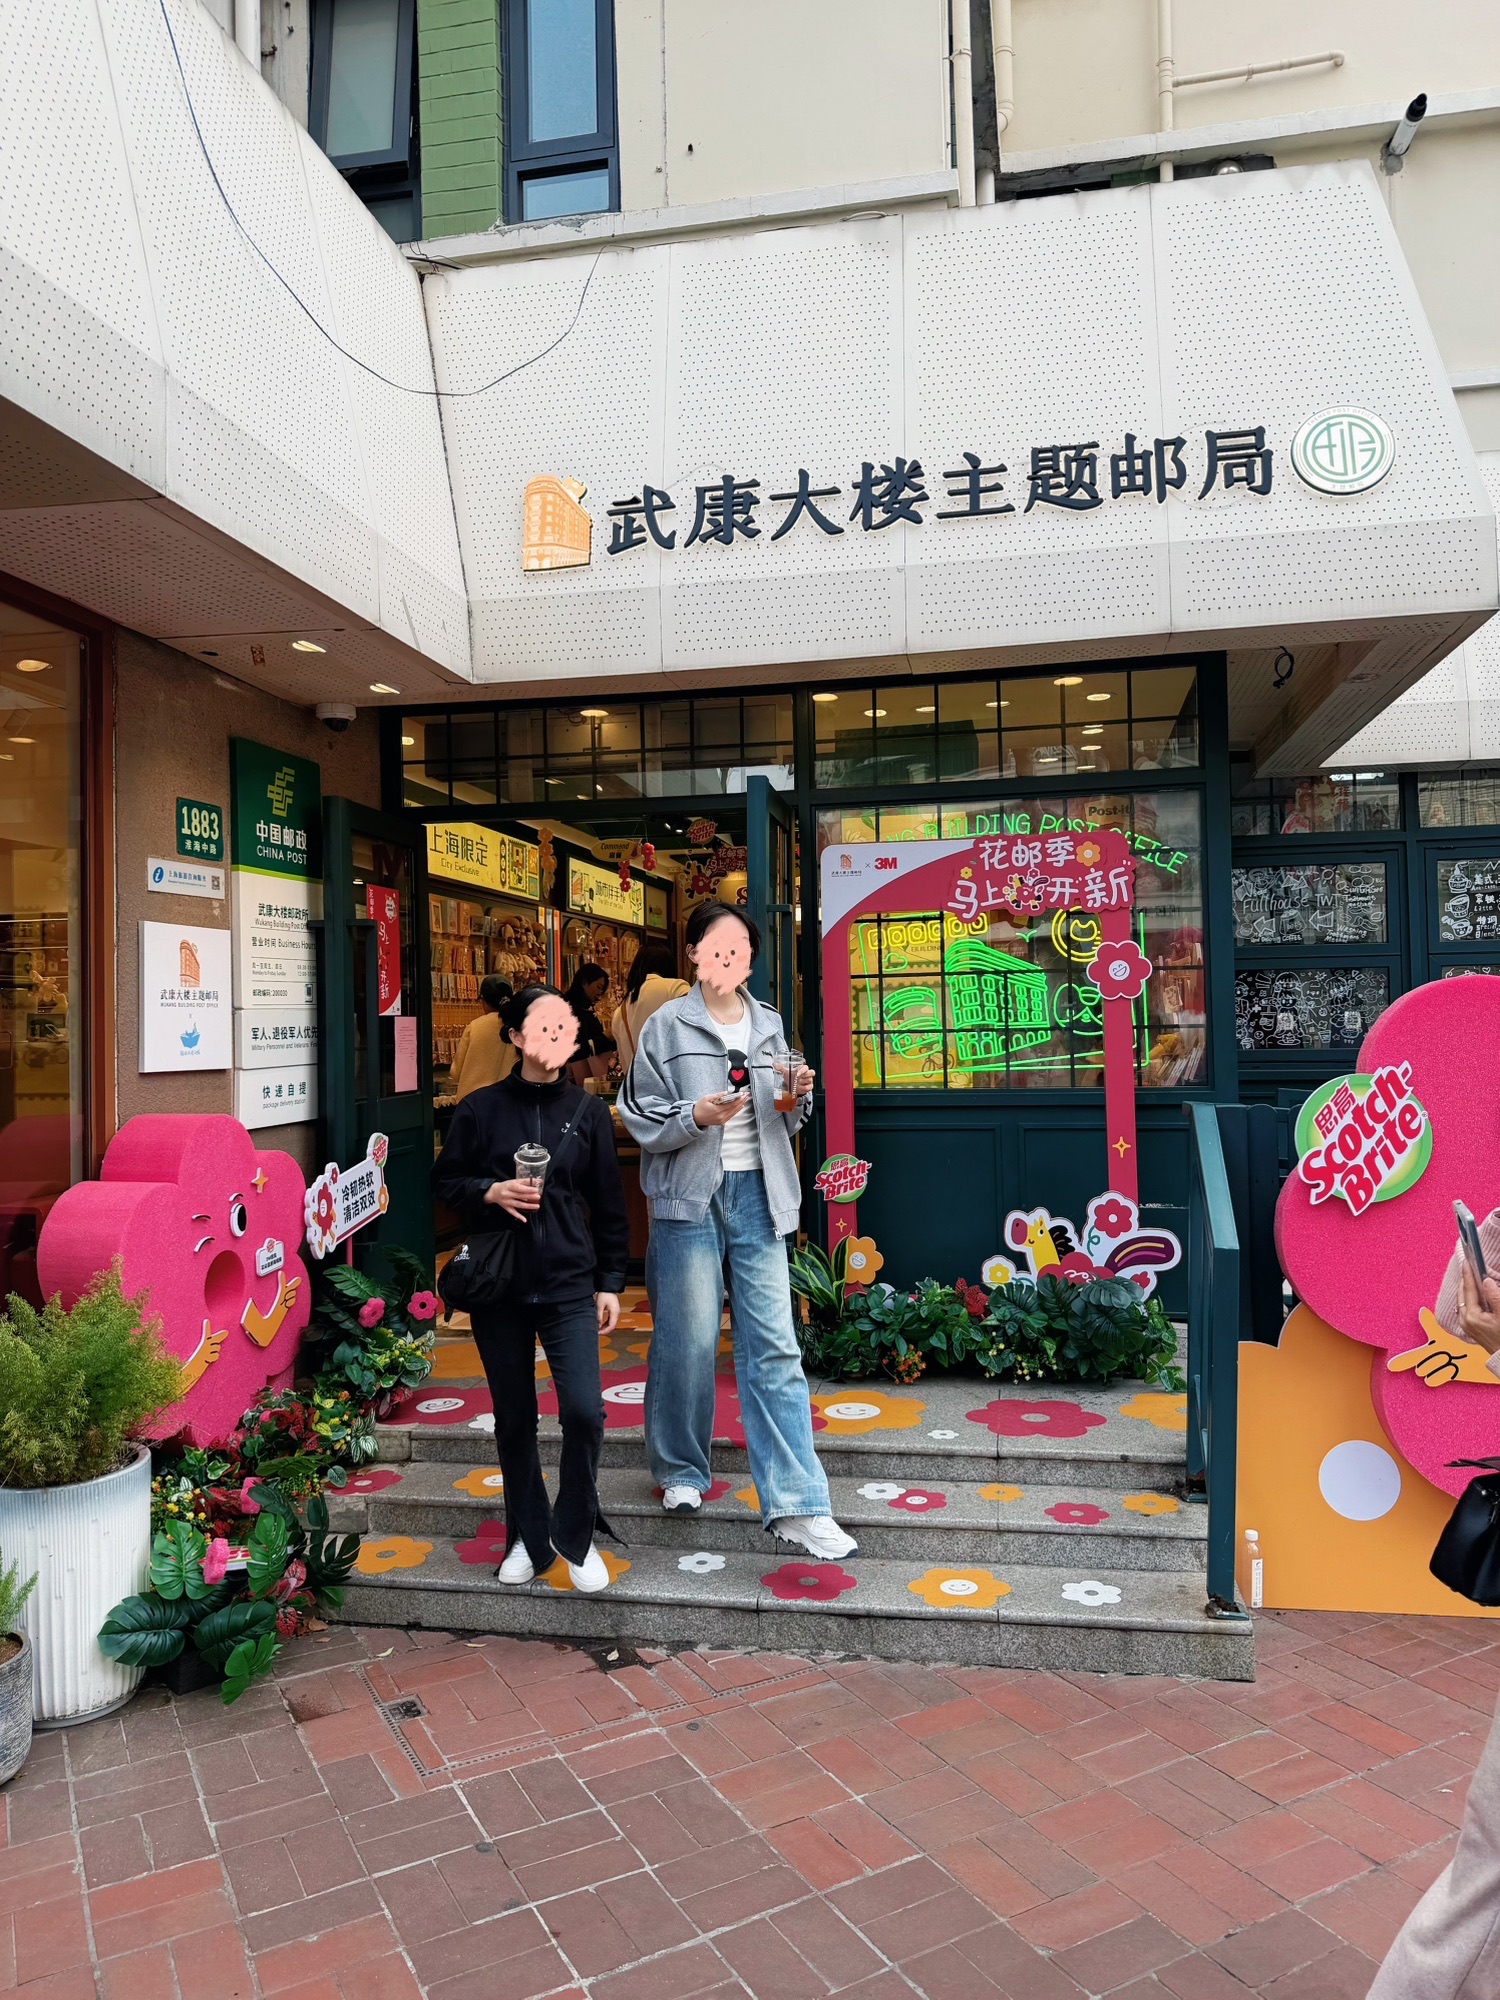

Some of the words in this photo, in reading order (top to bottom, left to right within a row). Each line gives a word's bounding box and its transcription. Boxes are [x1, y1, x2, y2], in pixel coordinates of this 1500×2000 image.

[1353, 409, 1375, 420] OFFICE
[605, 425, 1274, 556] 武康大楼主题邮局
[181, 806, 220, 840] 1883
[256, 820, 307, 850] 中国邮政
[185, 840, 217, 855] 淮海中路
[256, 845, 285, 860] CHINA
[287, 851, 307, 865] POST
[430, 826, 488, 867] 上海限定
[979, 836, 1076, 870] 花邮季
[441, 858, 453, 871] City
[455, 862, 480, 876] Exclusive
[874, 857, 897, 870] 3M
[258, 902, 309, 921] 武康大楼邮政所
[251, 936, 277, 948] 营业时间
[278, 939, 301, 949] Business
[160, 988, 219, 1002] 武康大楼主题邮局
[262, 1082, 307, 1099] 快递自提
[1314, 1082, 1357, 1140] 思高
[1340, 1103, 1423, 1212] Brite
[825, 1176, 865, 1200] Brite
[343, 1190, 376, 1224] 清洁双效
